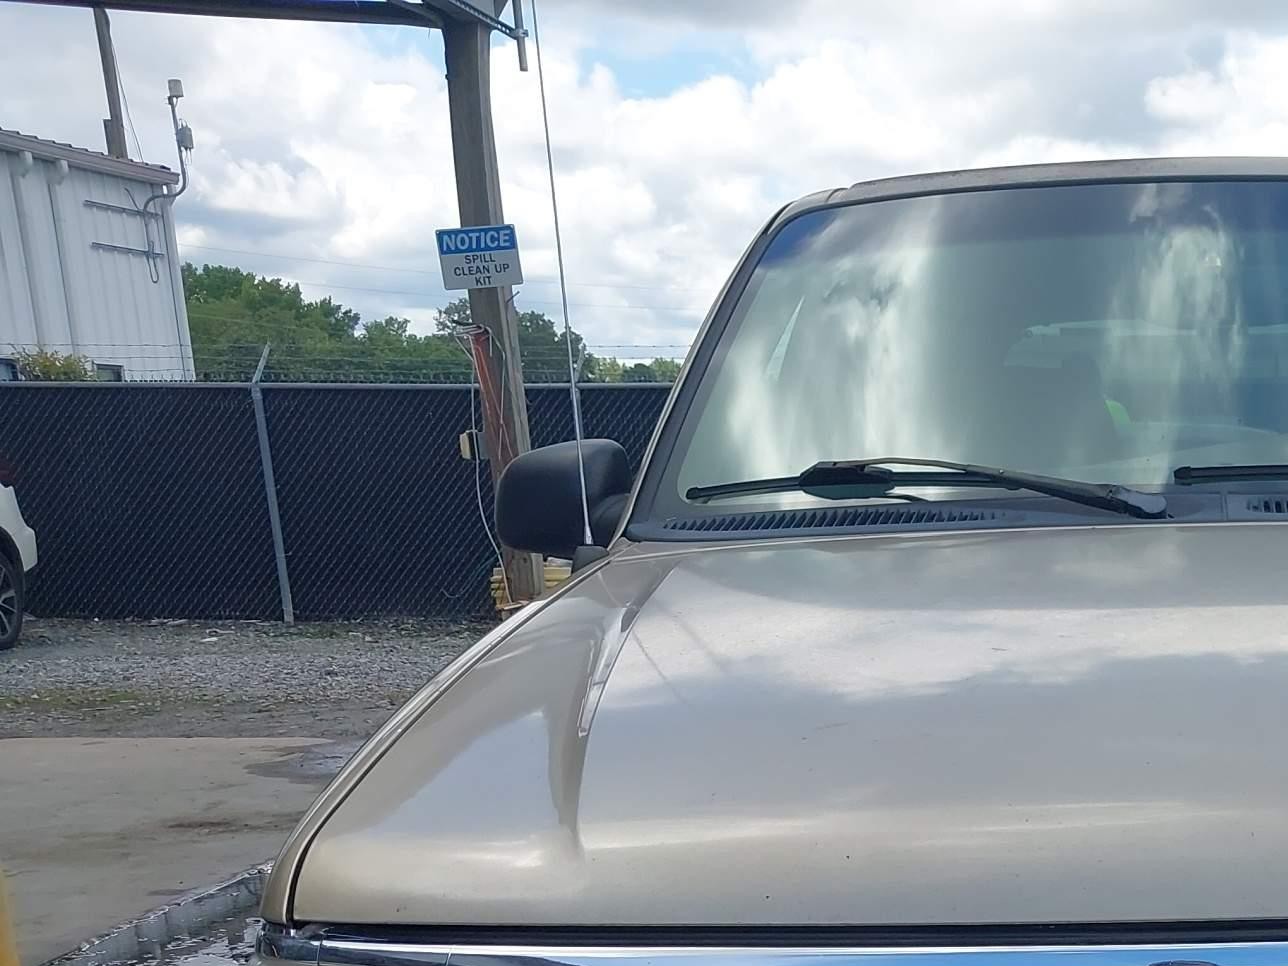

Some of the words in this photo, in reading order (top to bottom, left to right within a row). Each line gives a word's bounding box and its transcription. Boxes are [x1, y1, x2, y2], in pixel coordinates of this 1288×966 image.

[442, 230, 511, 251] NOTICE
[464, 253, 496, 264] SPILL
[453, 265, 490, 276] CLEAN
[494, 263, 510, 273] UP
[475, 276, 492, 286] KIT
